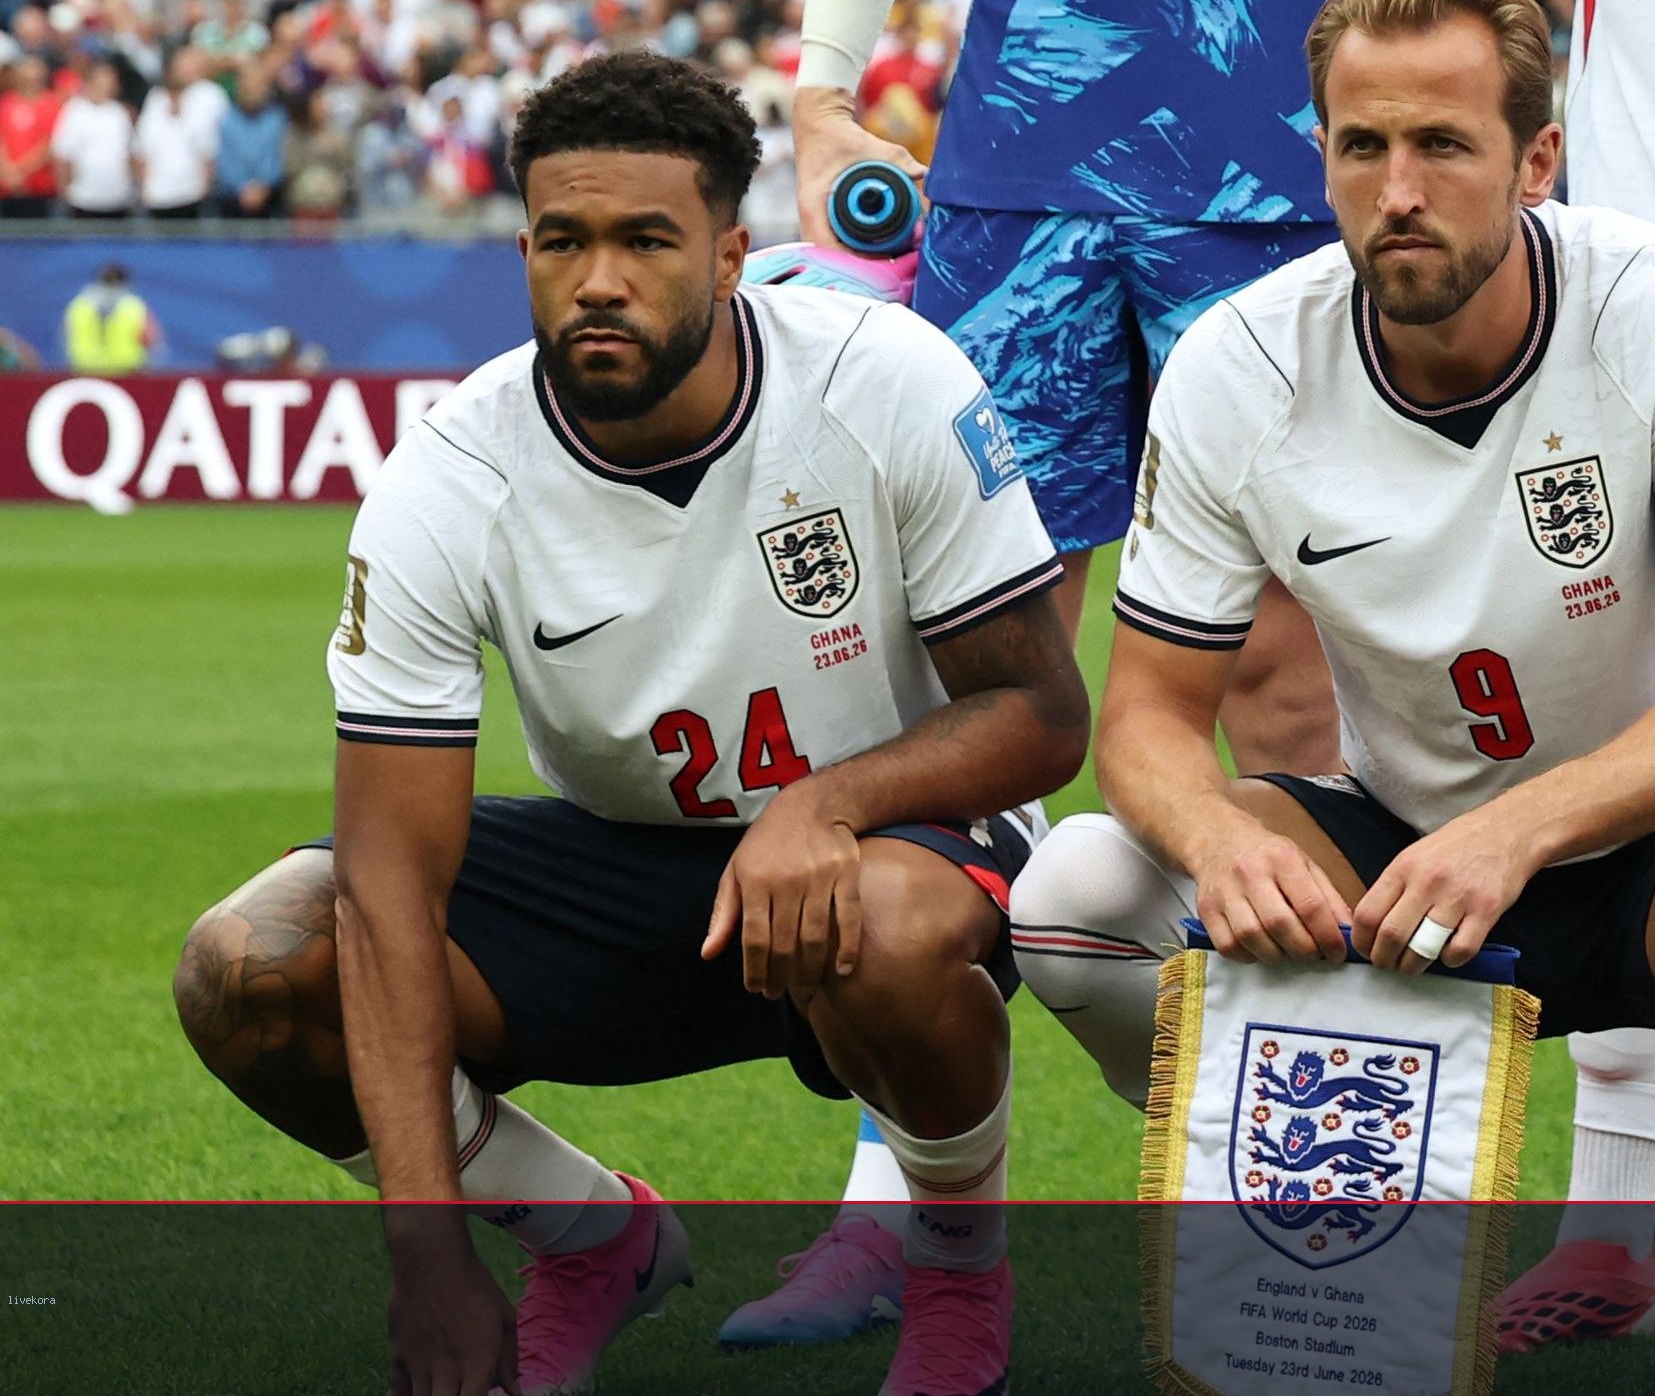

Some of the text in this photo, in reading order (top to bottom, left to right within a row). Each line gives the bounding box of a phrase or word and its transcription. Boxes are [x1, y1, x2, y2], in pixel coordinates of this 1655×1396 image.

[1561, 574, 1616, 601] GHANA
[1565, 590, 1621, 620] 23.06.26
[810, 622, 863, 650] GHANA
[813, 639, 868, 670] 23.06.26
[1448, 648, 1535, 761] 9
[650, 686, 812, 818] 24
[918, 1210, 973, 1239] ENG
[1256, 1278, 1365, 1305] England v Ghana
[1240, 1302, 1378, 1333] FIFA World Cup 2026
[1255, 1331, 1356, 1358] Boston Stadium
[1225, 1353, 1383, 1387] Tuesday 23rd June 2026
